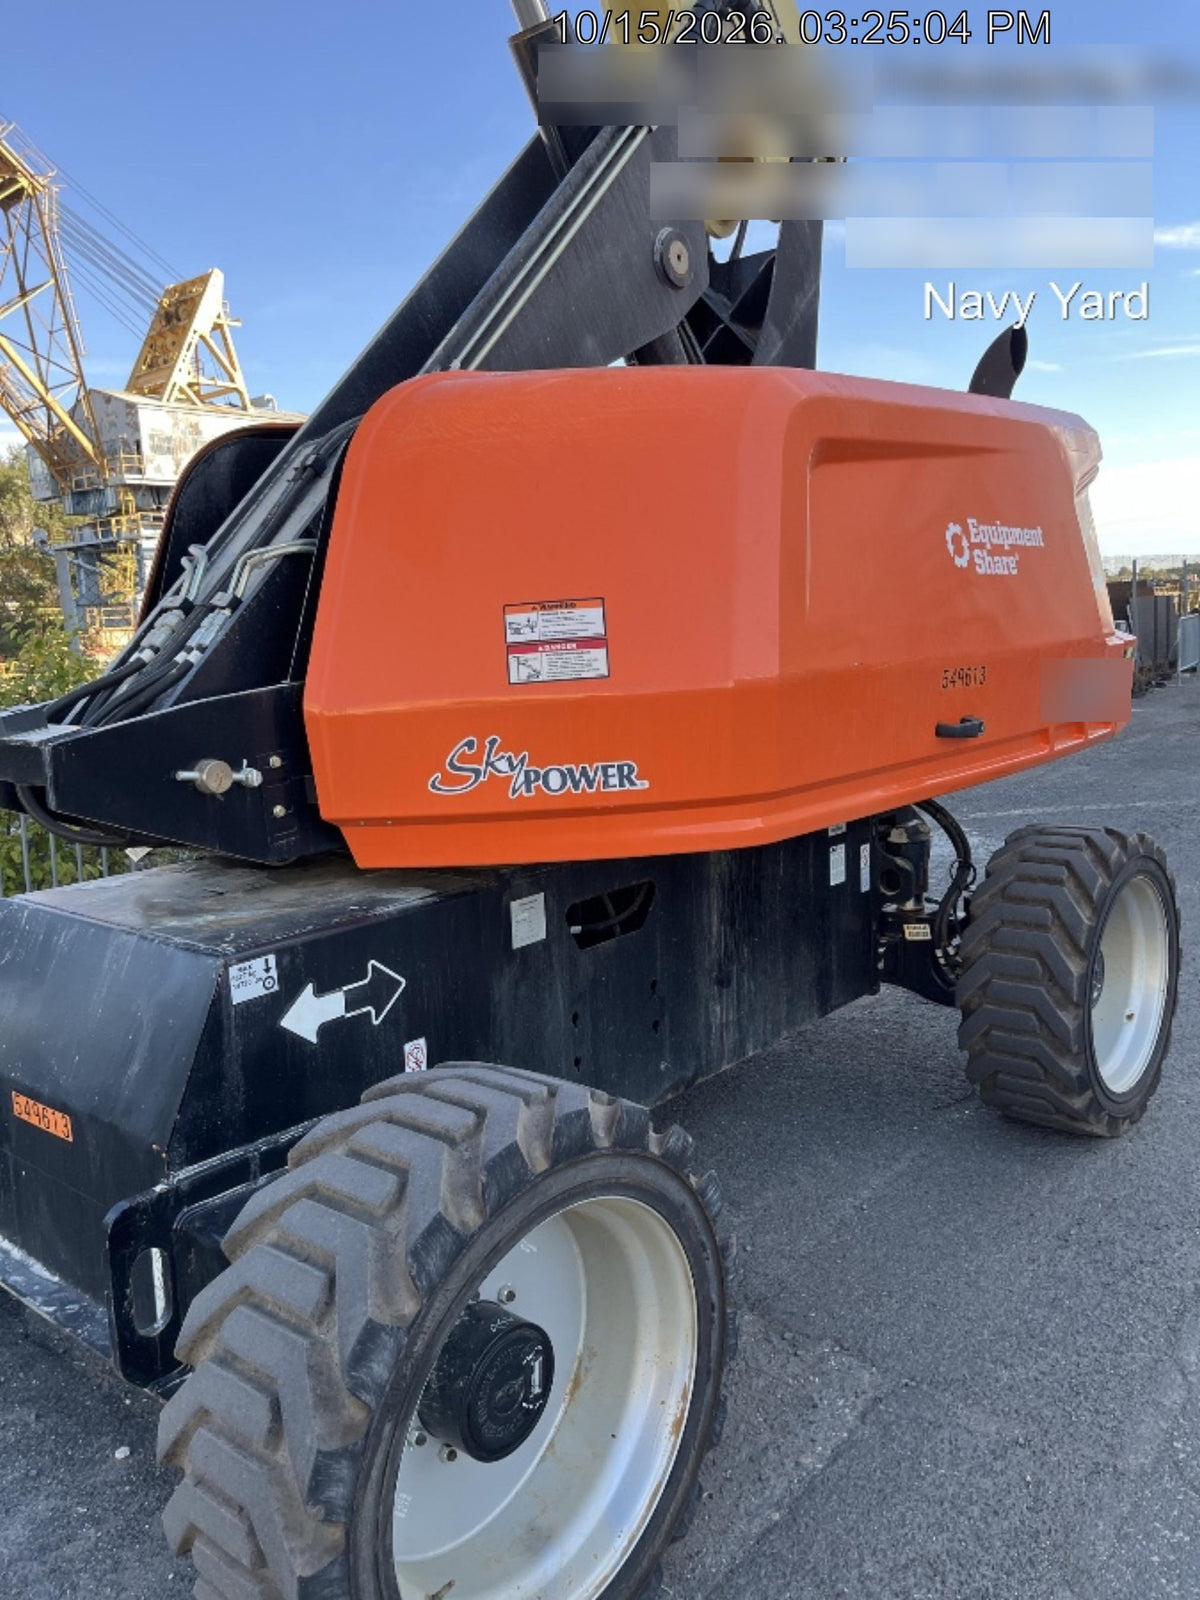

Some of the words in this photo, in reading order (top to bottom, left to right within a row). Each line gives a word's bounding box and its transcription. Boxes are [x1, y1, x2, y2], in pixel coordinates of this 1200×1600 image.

[966, 518, 1044, 550] Equipment
[973, 548, 1018, 575] Share
[941, 665, 986, 689] 549613
[14, 1092, 70, 1139] 549613
